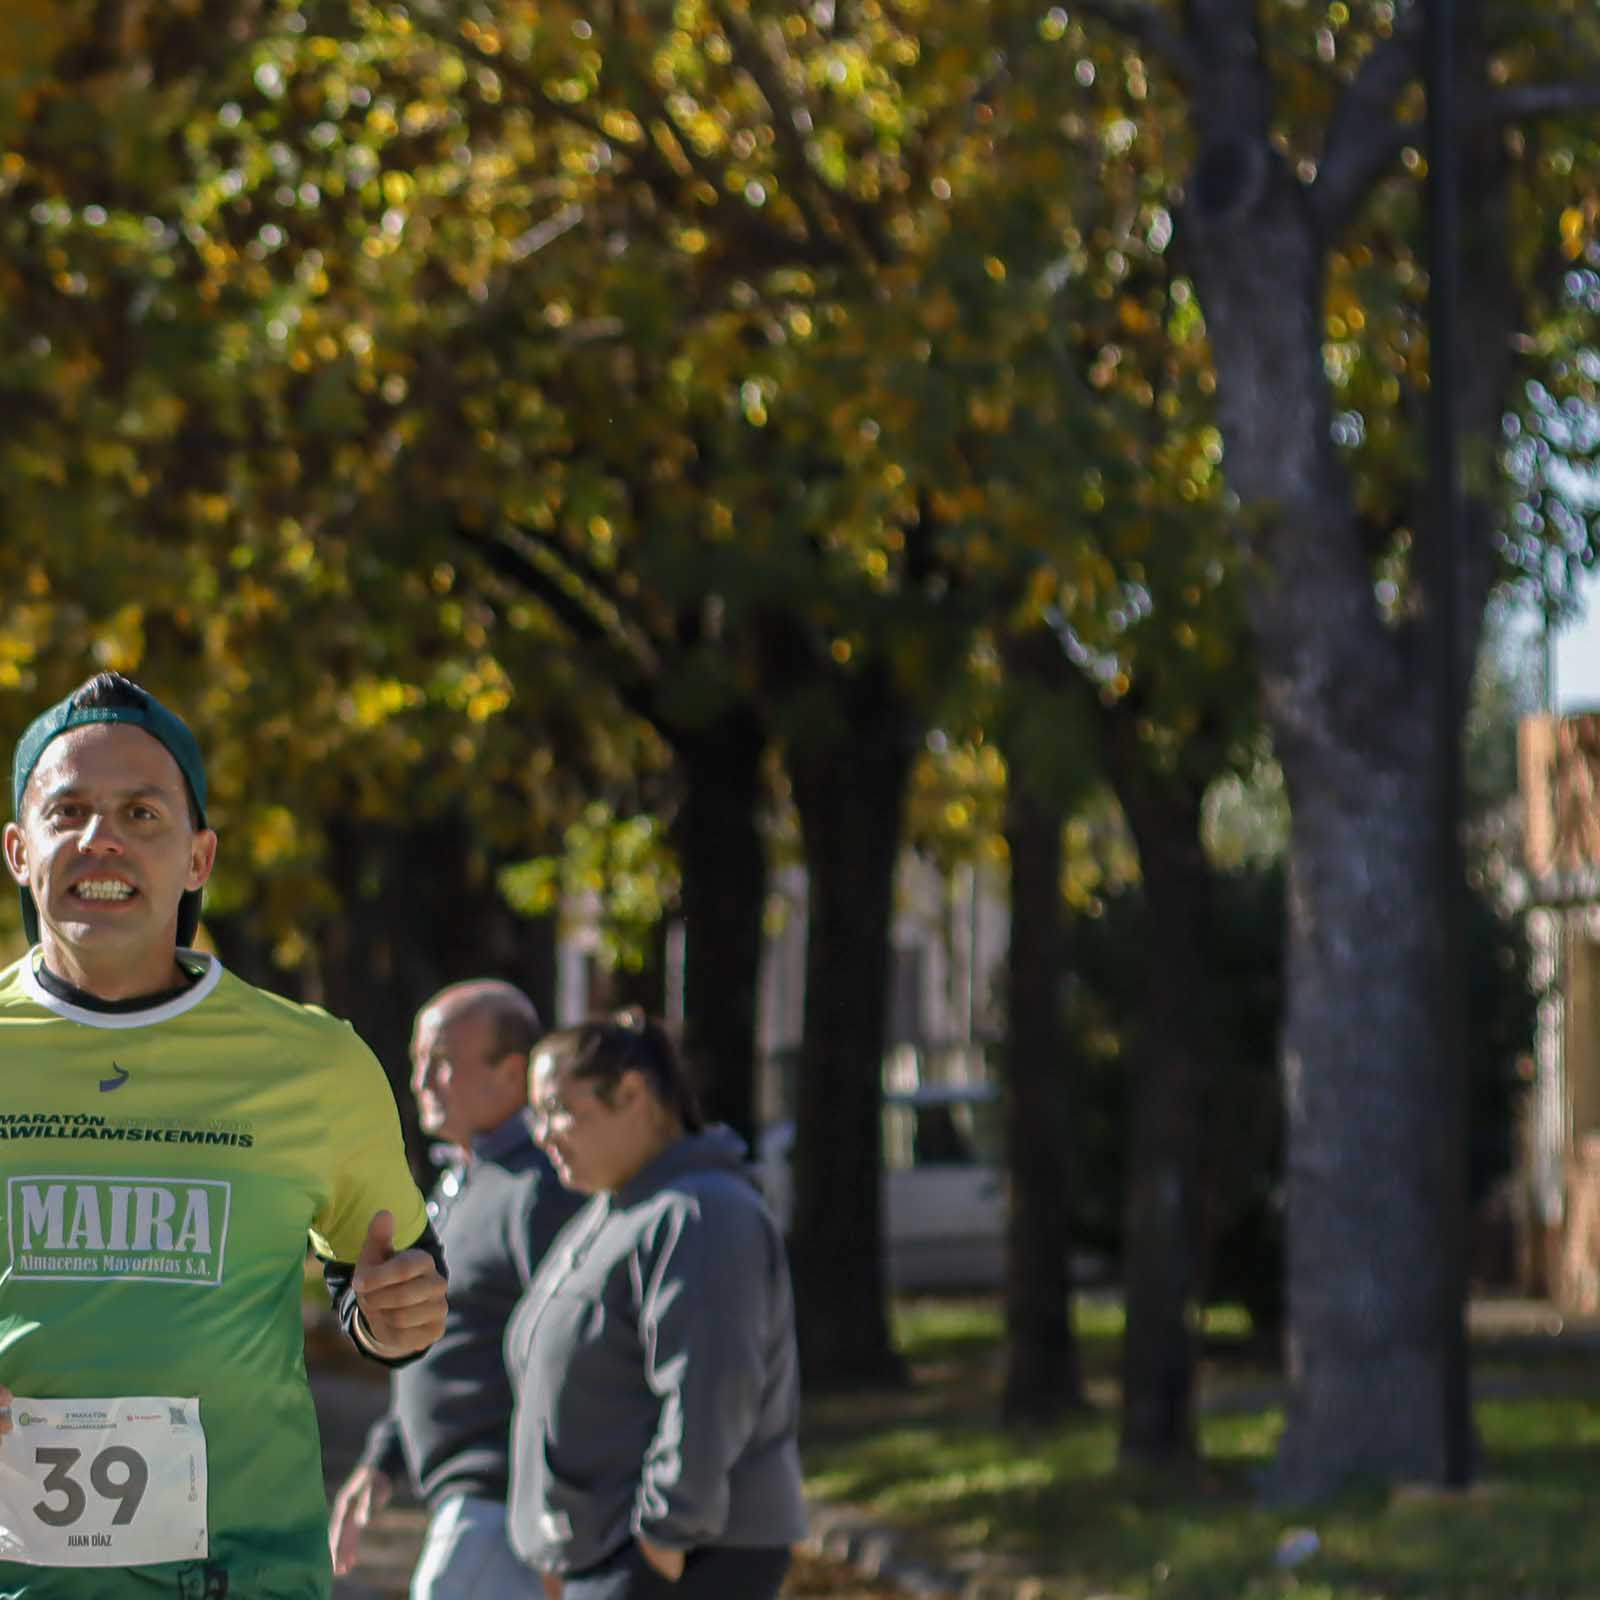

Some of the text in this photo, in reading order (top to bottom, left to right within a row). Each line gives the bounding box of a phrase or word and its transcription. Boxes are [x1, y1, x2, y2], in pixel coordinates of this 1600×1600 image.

[20, 1184, 211, 1255] MAIRA
[20, 1254, 211, 1276] Almacenes Mayoristas S.A.
[32, 1445, 149, 1527] 39
[67, 1531, 112, 1547] JUAN DÍAZ
